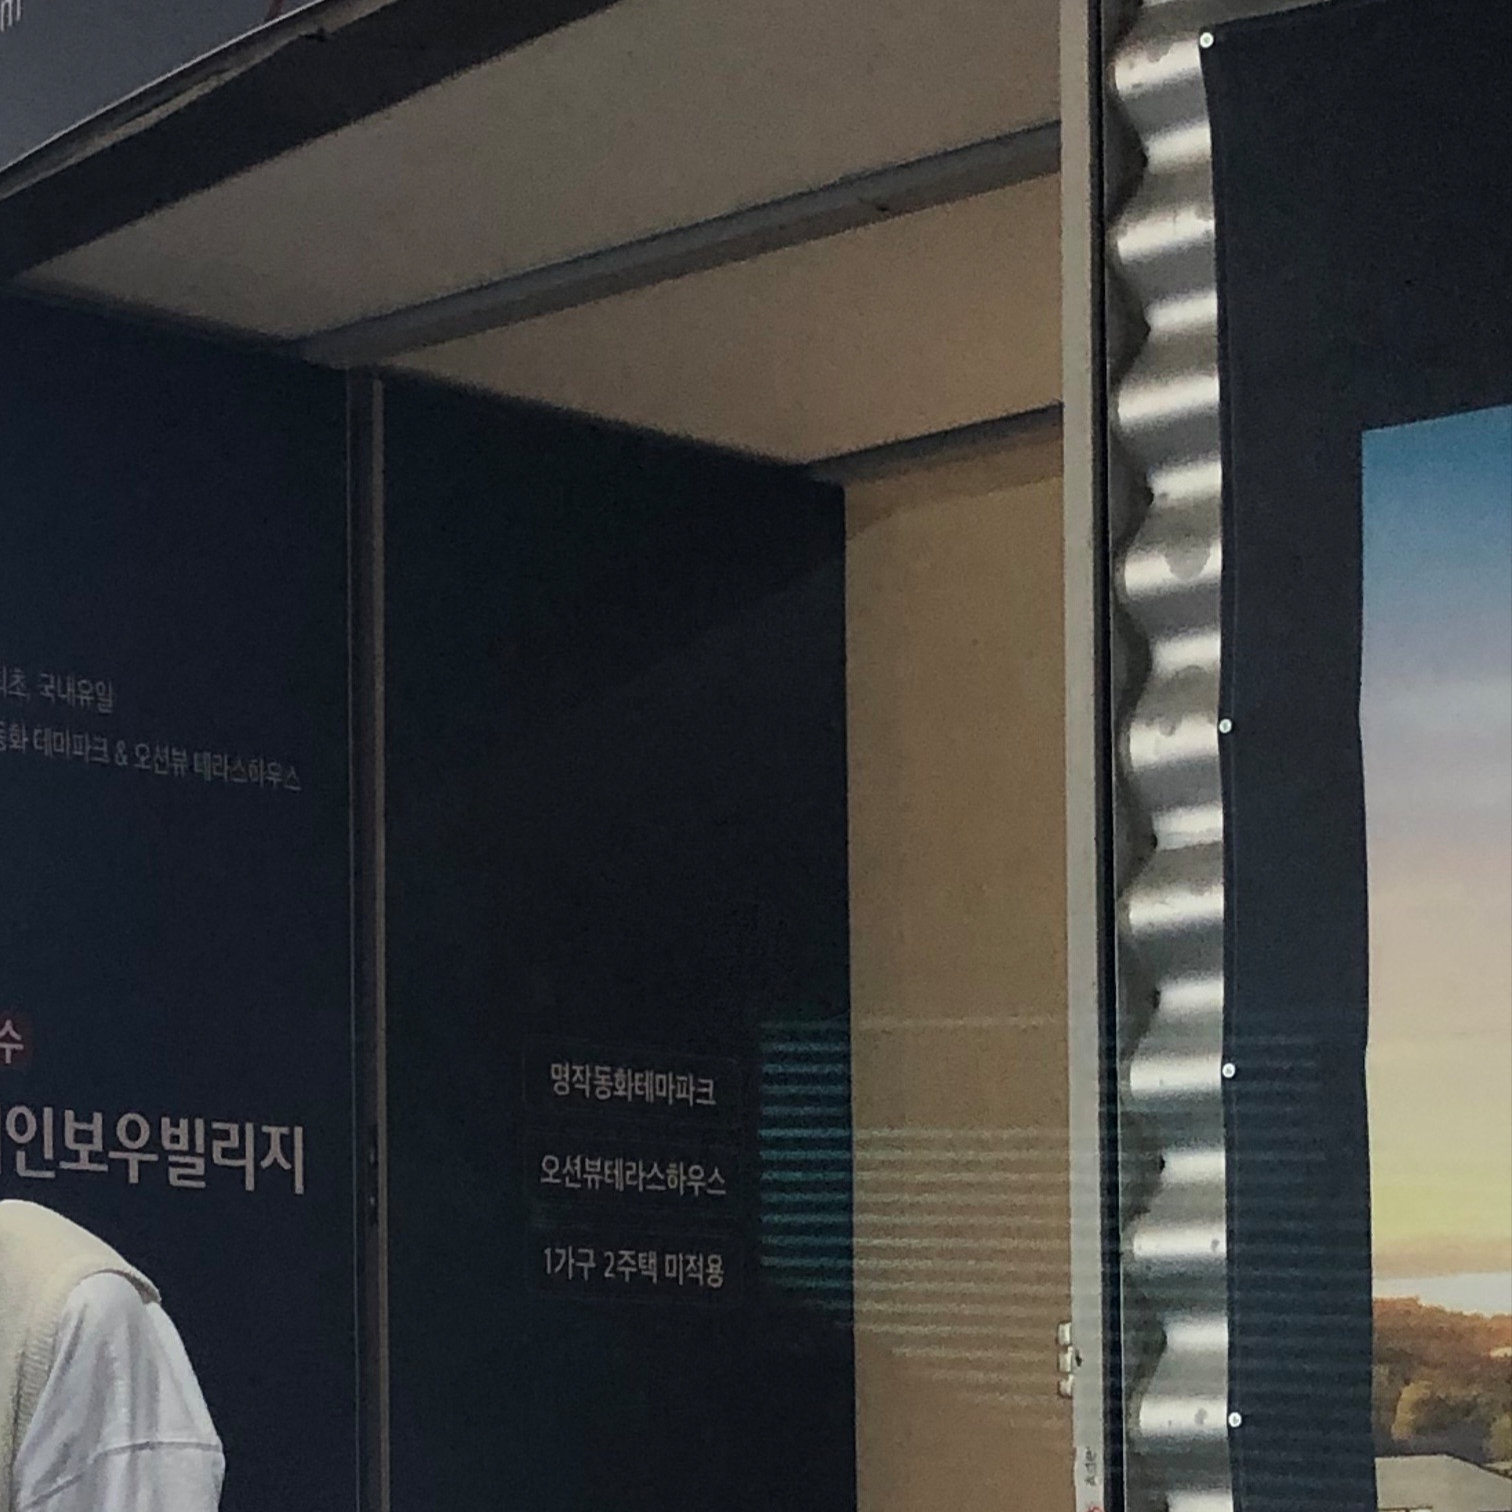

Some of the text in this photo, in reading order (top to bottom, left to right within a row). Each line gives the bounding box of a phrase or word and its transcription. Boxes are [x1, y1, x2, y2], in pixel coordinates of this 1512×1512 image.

[39, 673, 115, 714] 국내유일
[32, 727, 111, 764] 테마파크
[115, 740, 129, 768] &
[133, 743, 188, 777] 오션뷰
[193, 750, 302, 792] 테라스하우스
[550, 1061, 717, 1107] 명작동화테마파크
[540, 1154, 727, 1197] 오션뷰테라스하우스
[544, 1245, 725, 1288] 1가구 2주택 미적용
